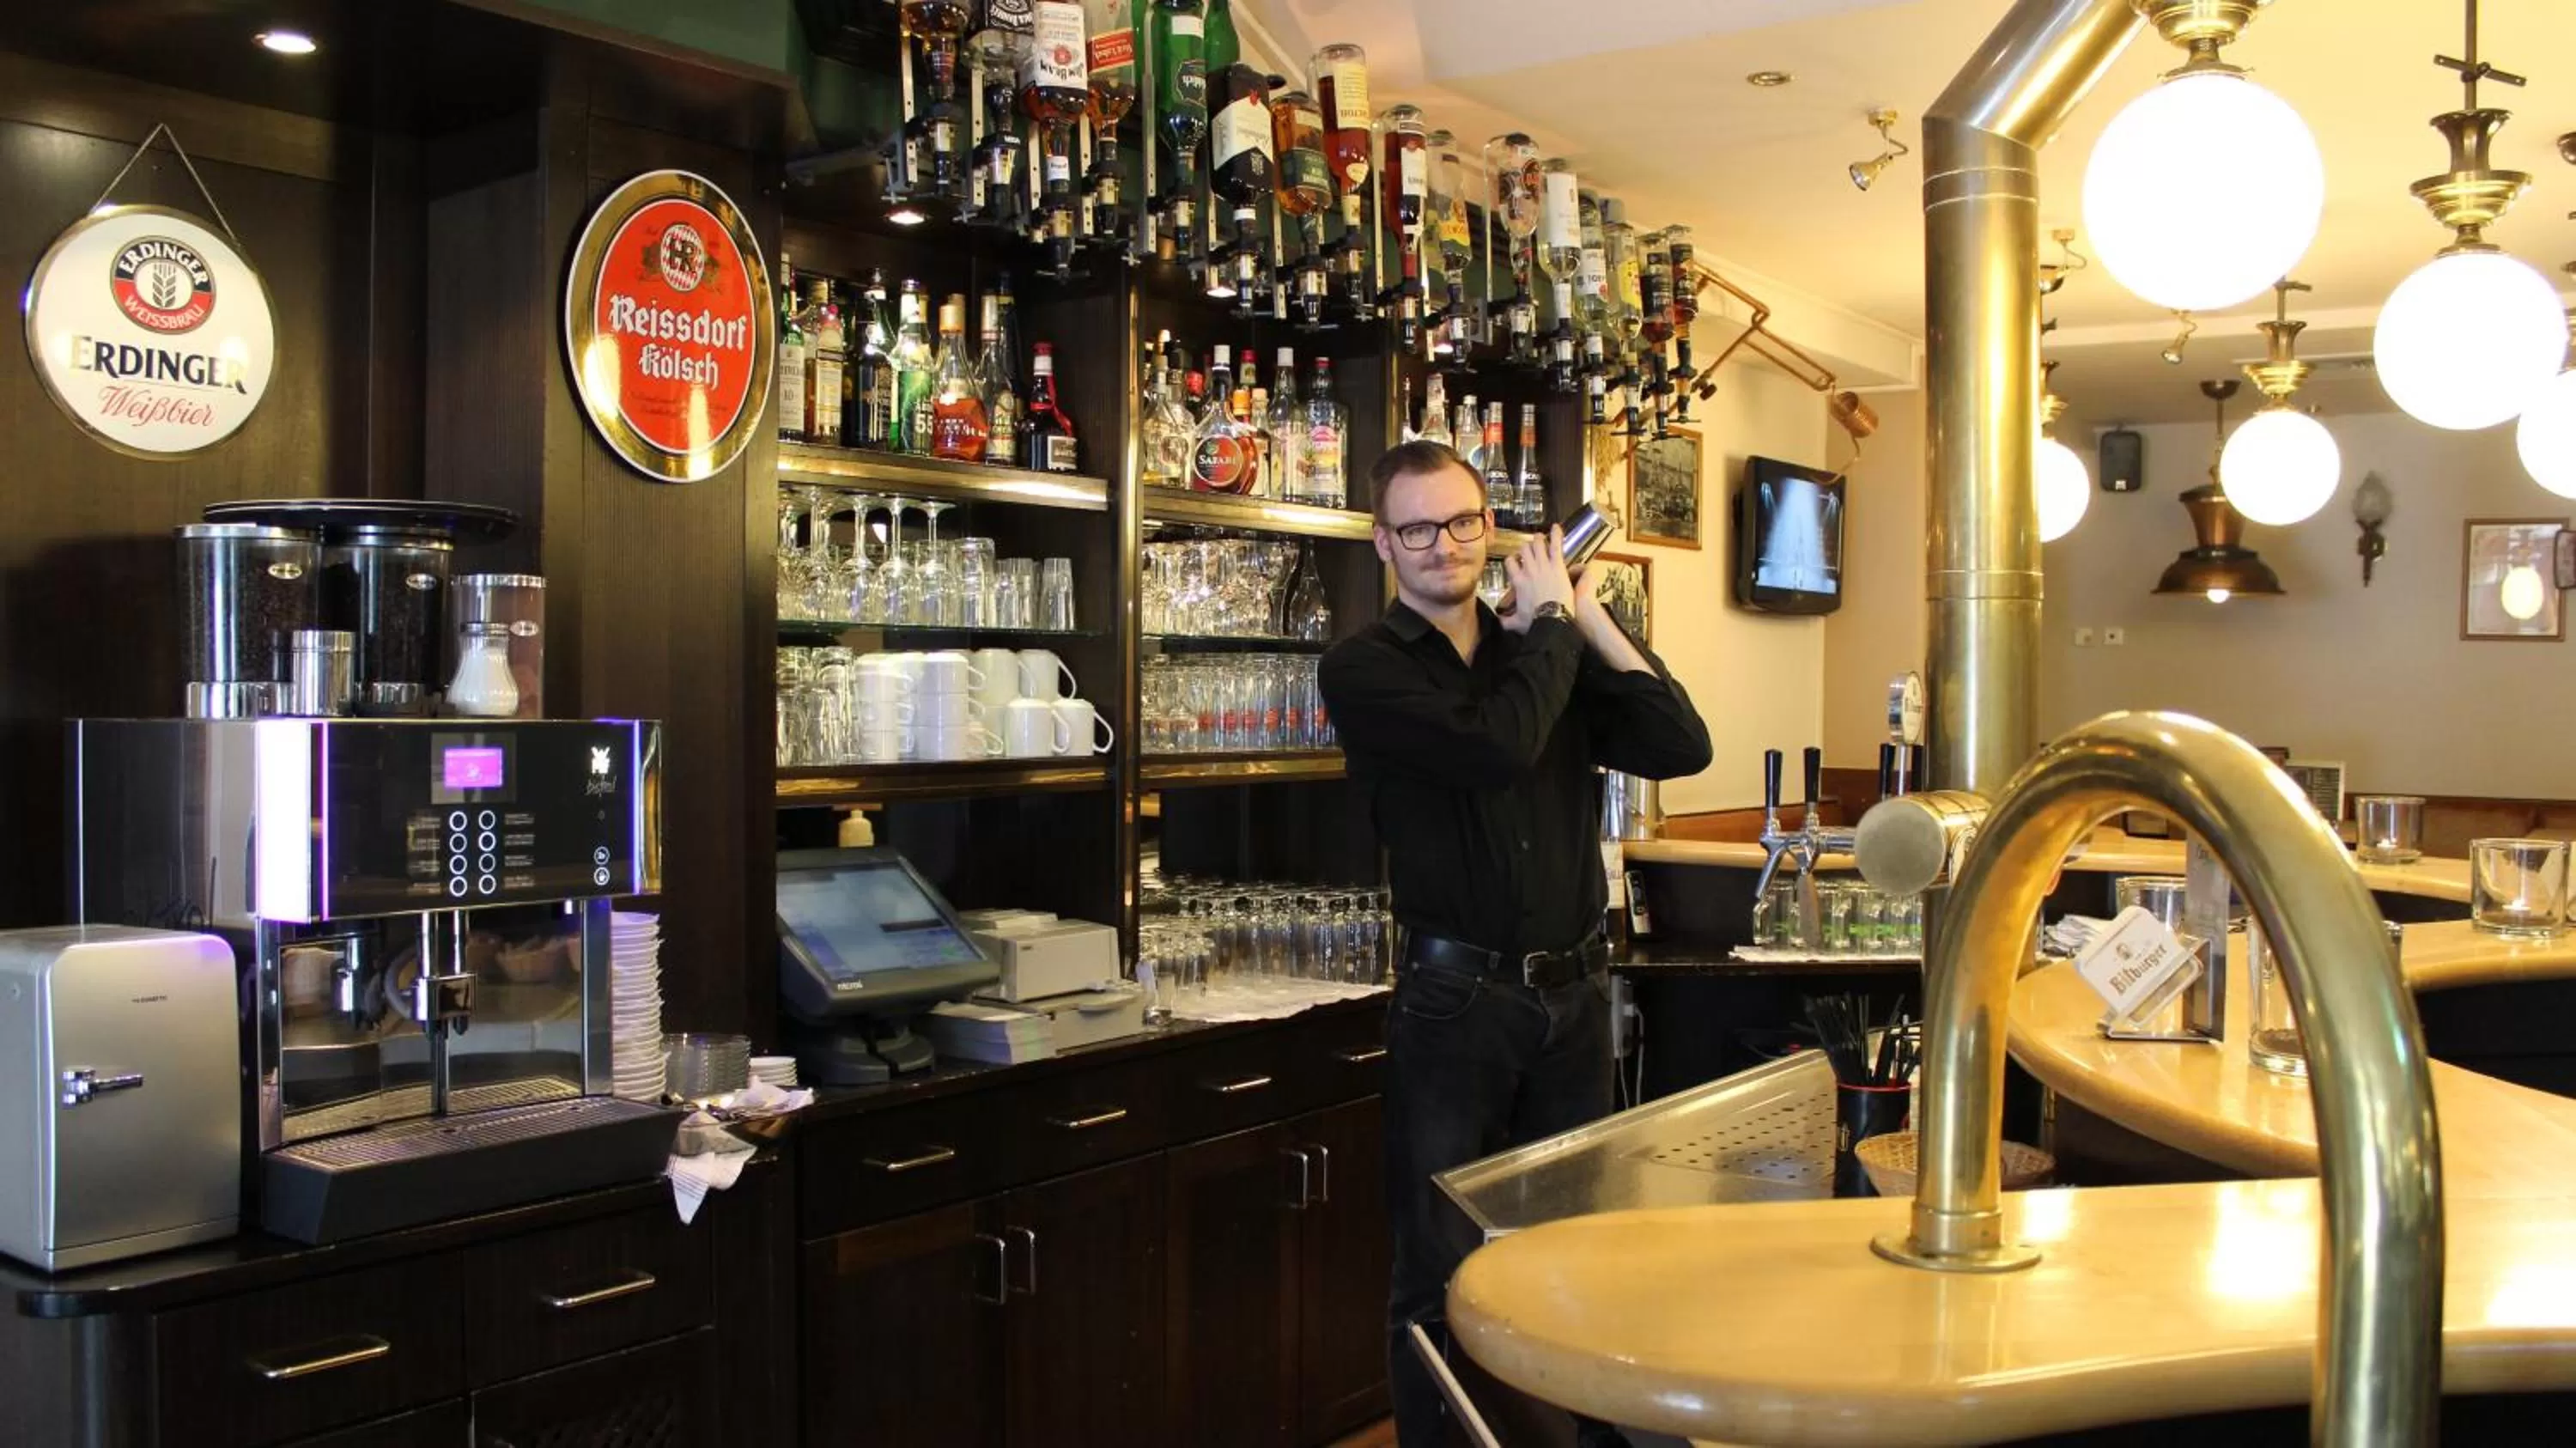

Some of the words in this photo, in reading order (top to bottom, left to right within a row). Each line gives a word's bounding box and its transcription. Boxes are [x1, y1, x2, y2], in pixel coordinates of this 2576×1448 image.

[118, 240, 209, 286] ERDINGER
[609, 294, 747, 351] Reissdorf
[70, 335, 247, 395] ERDINGER
[639, 342, 720, 391] Kölsch
[99, 386, 215, 428] Weißbier
[2109, 943, 2167, 996] Bitburger
